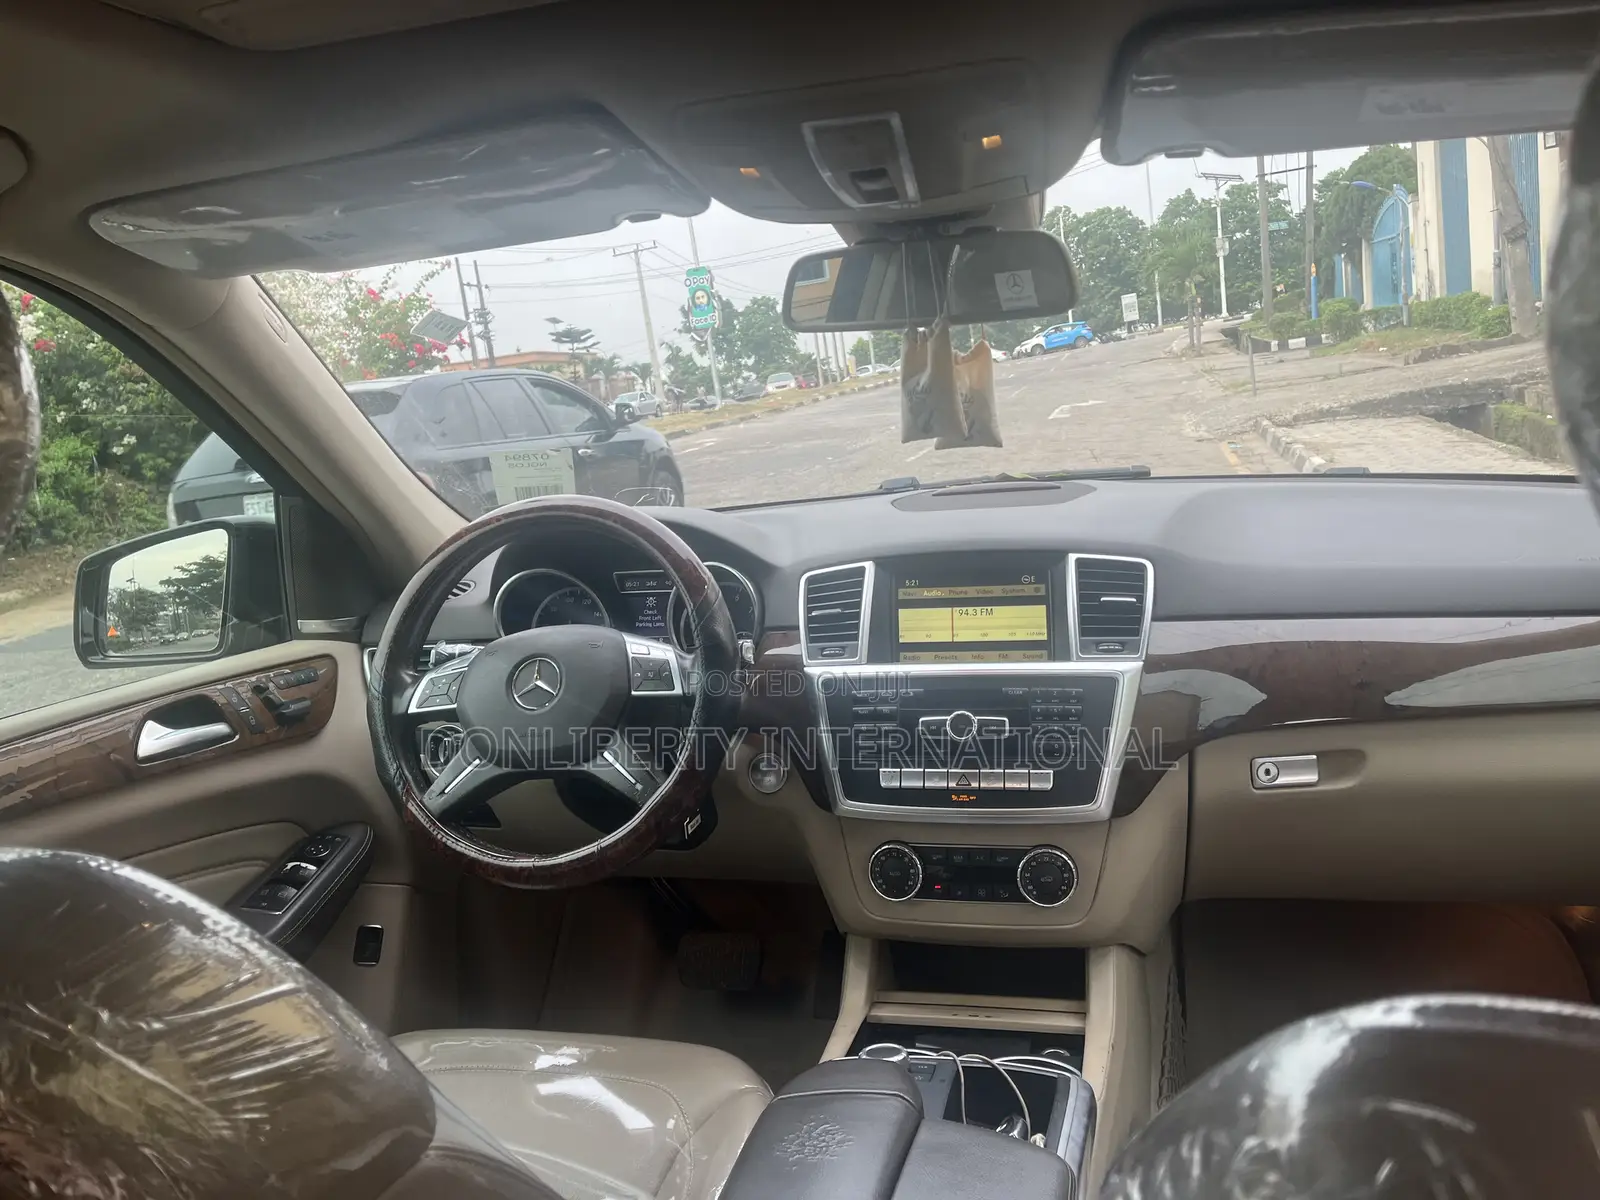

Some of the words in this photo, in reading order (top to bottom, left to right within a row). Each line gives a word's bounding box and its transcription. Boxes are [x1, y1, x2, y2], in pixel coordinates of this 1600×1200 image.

[905, 579, 919, 587] 5:21
[958, 608, 978, 617] 94.3
[980, 607, 994, 616] FM
